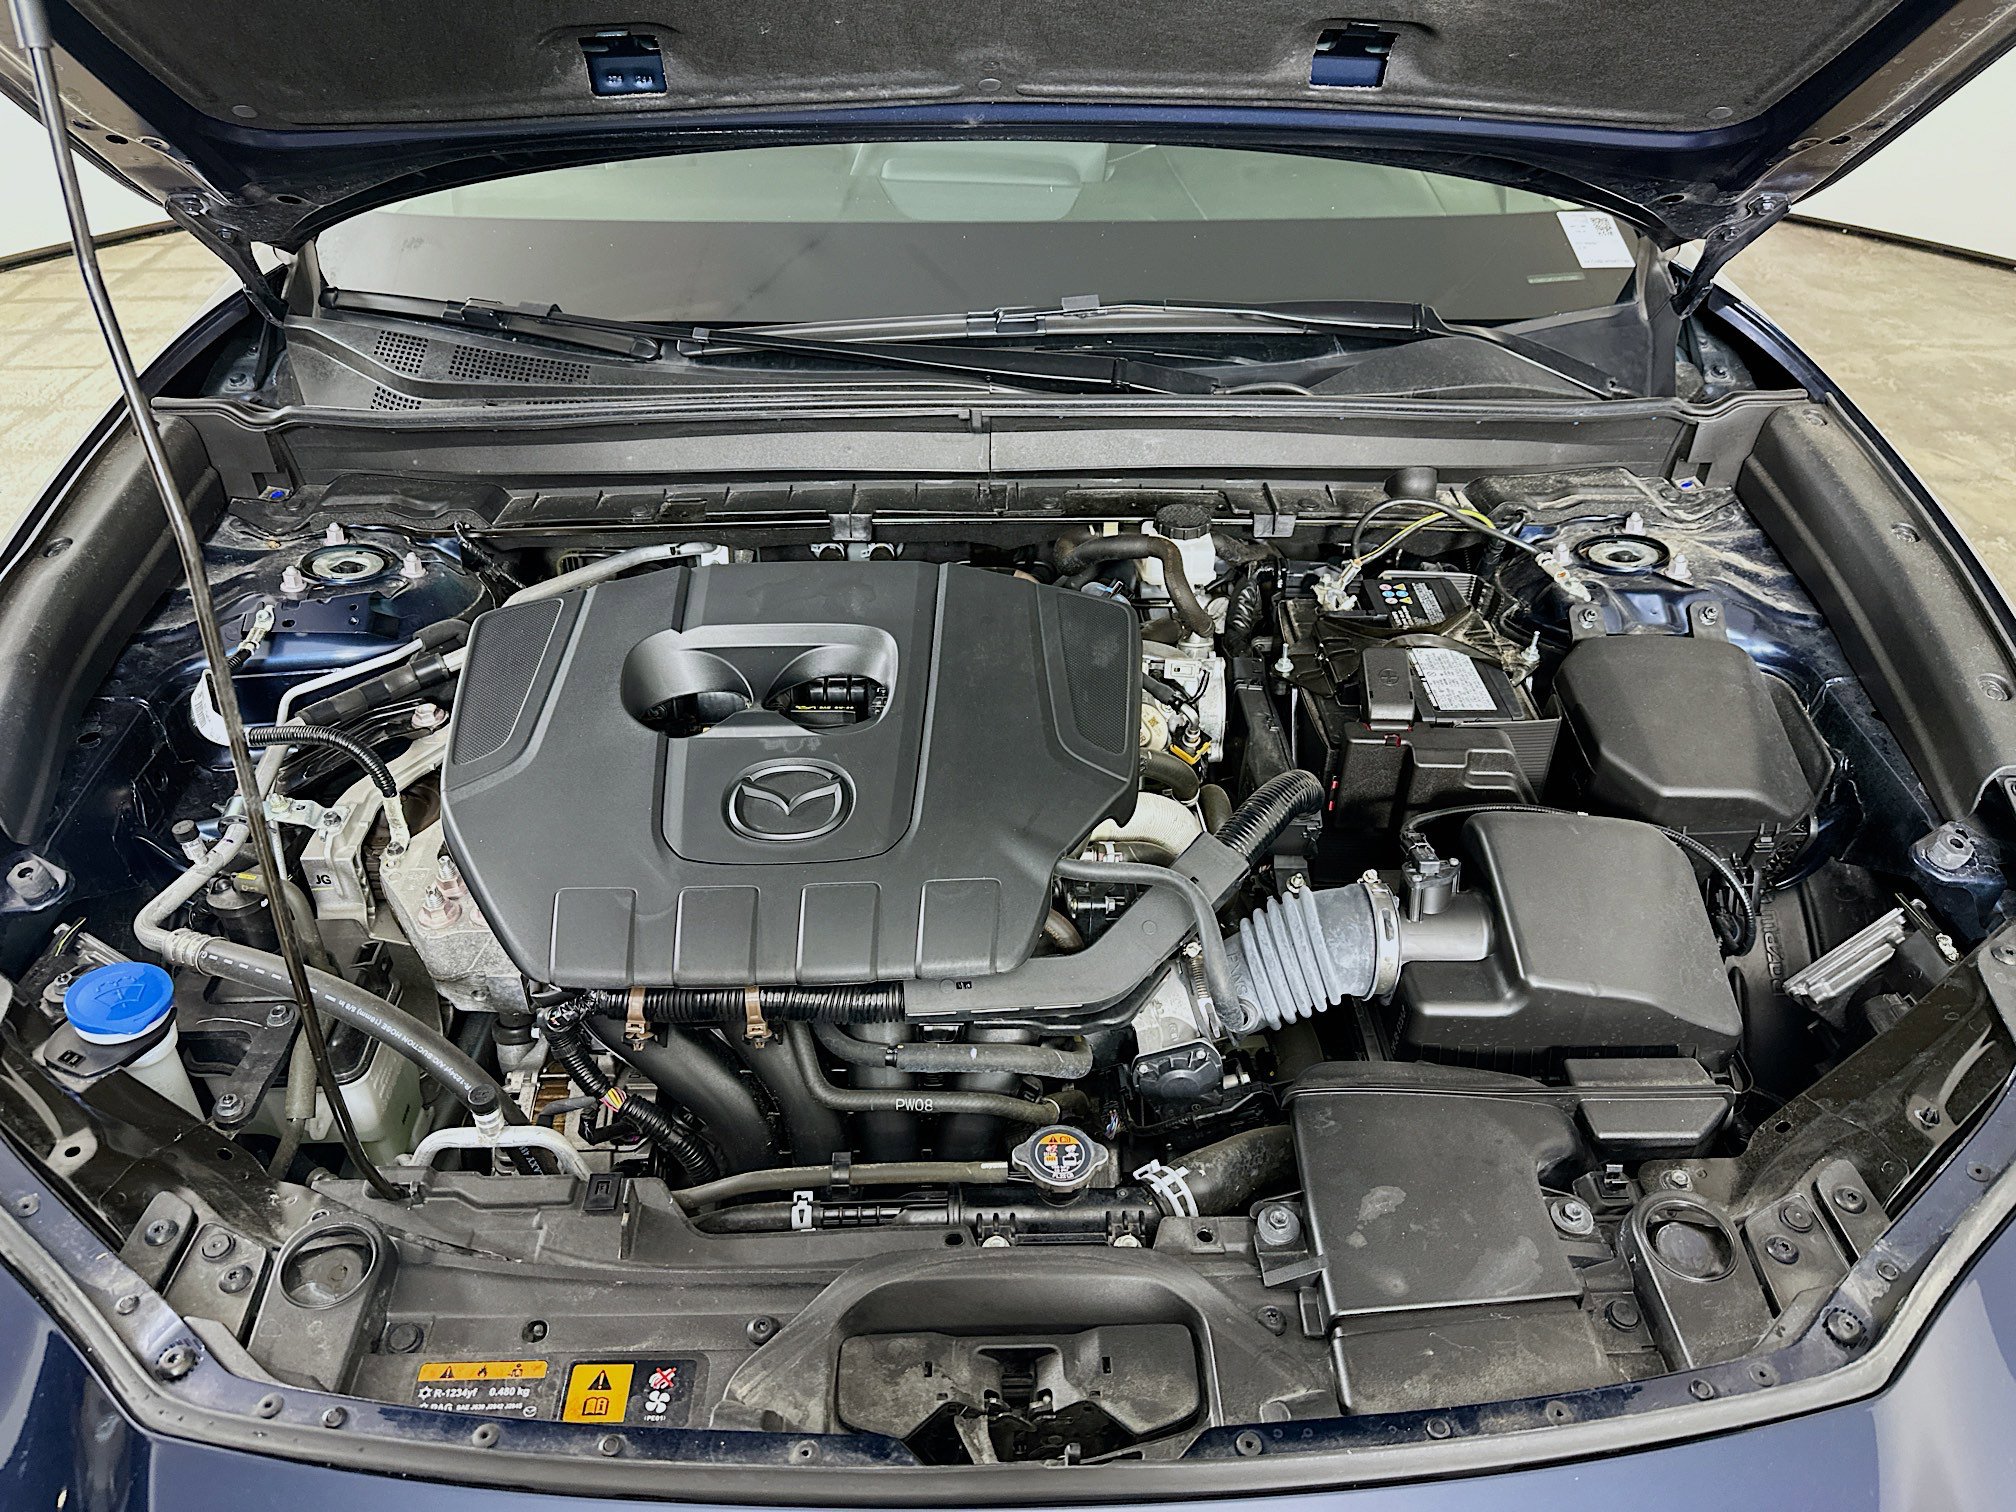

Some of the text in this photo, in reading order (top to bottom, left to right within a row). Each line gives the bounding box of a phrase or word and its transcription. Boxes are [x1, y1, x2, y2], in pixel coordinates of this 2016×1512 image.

[316, 873, 332, 885] JG
[381, 1022, 402, 1040] HOSE
[401, 1035, 433, 1060] SUCTION
[895, 1098, 933, 1111] PW08
[433, 1387, 478, 1399] R-1234yf
[516, 1386, 531, 1398] kg
